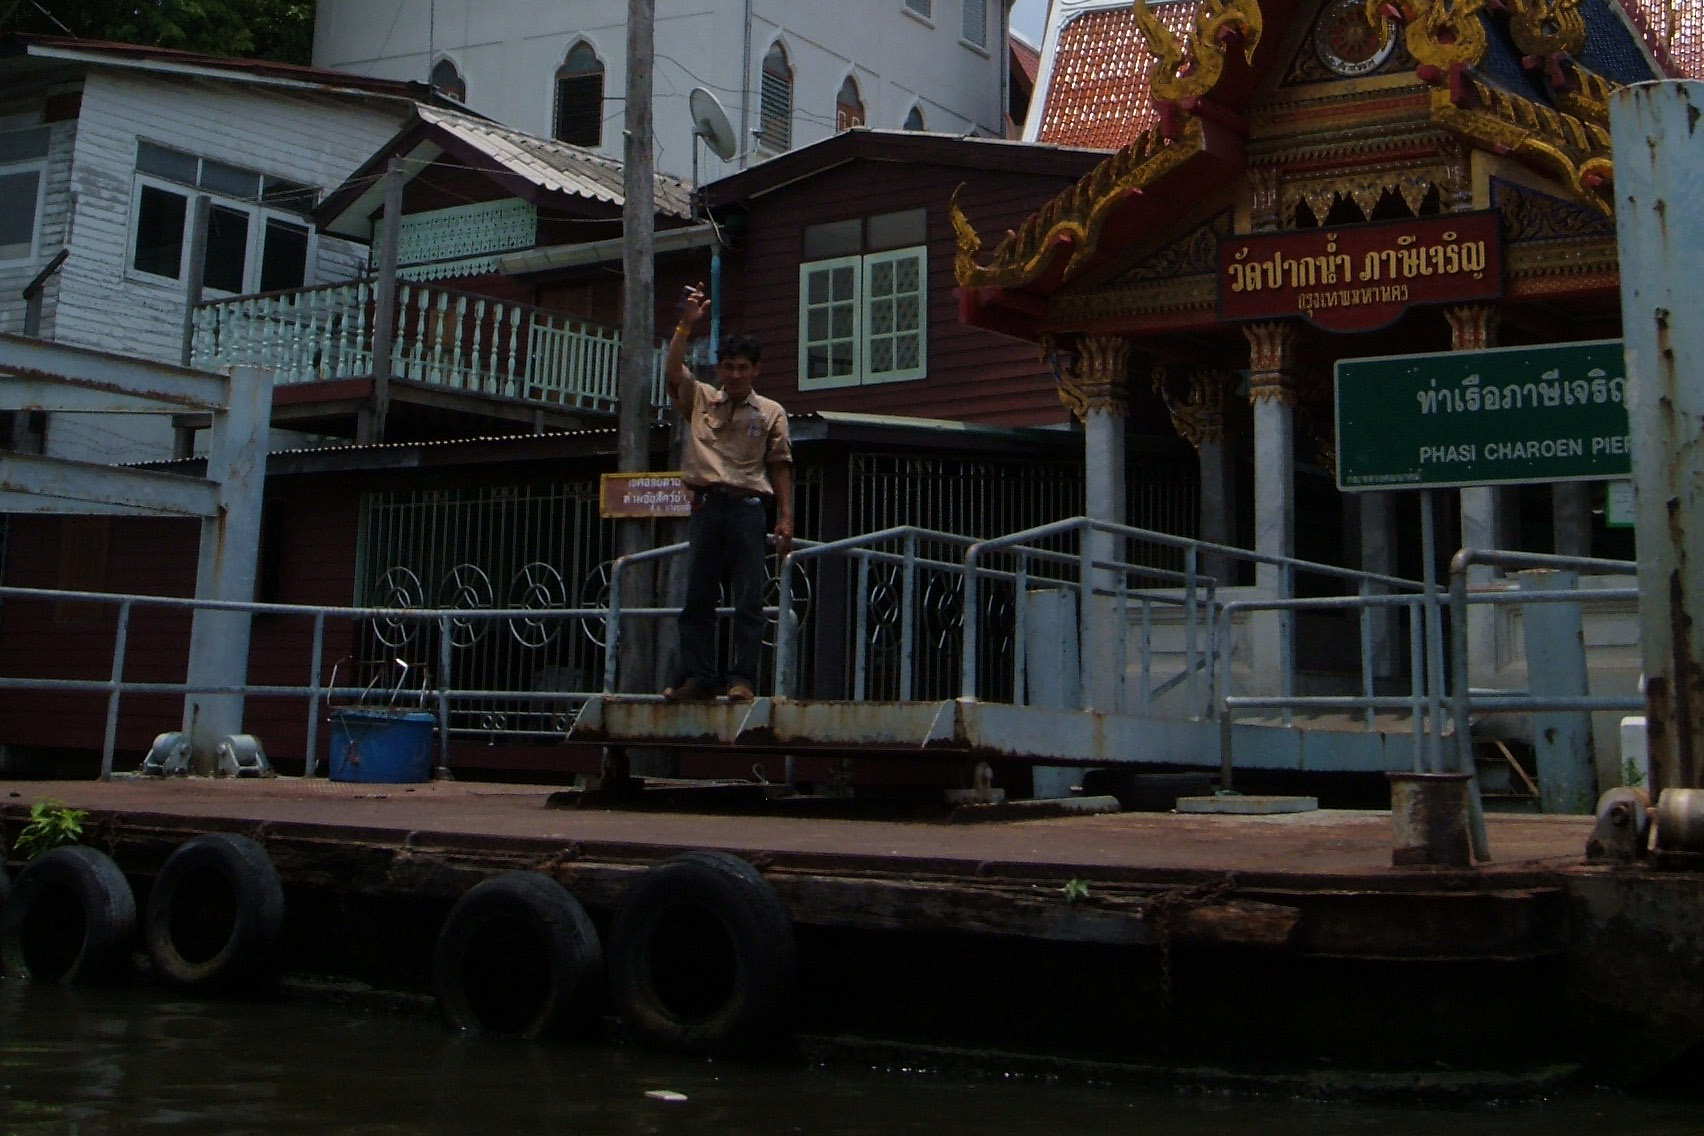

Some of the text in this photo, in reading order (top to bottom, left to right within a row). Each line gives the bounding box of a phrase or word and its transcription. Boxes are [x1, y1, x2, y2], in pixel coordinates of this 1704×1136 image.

[1228, 231, 1485, 292] วัดปากน้ำ ภาษีเจริญ
[1419, 445, 1476, 463] PHASI
[1484, 438, 1583, 461] CHAROEN
